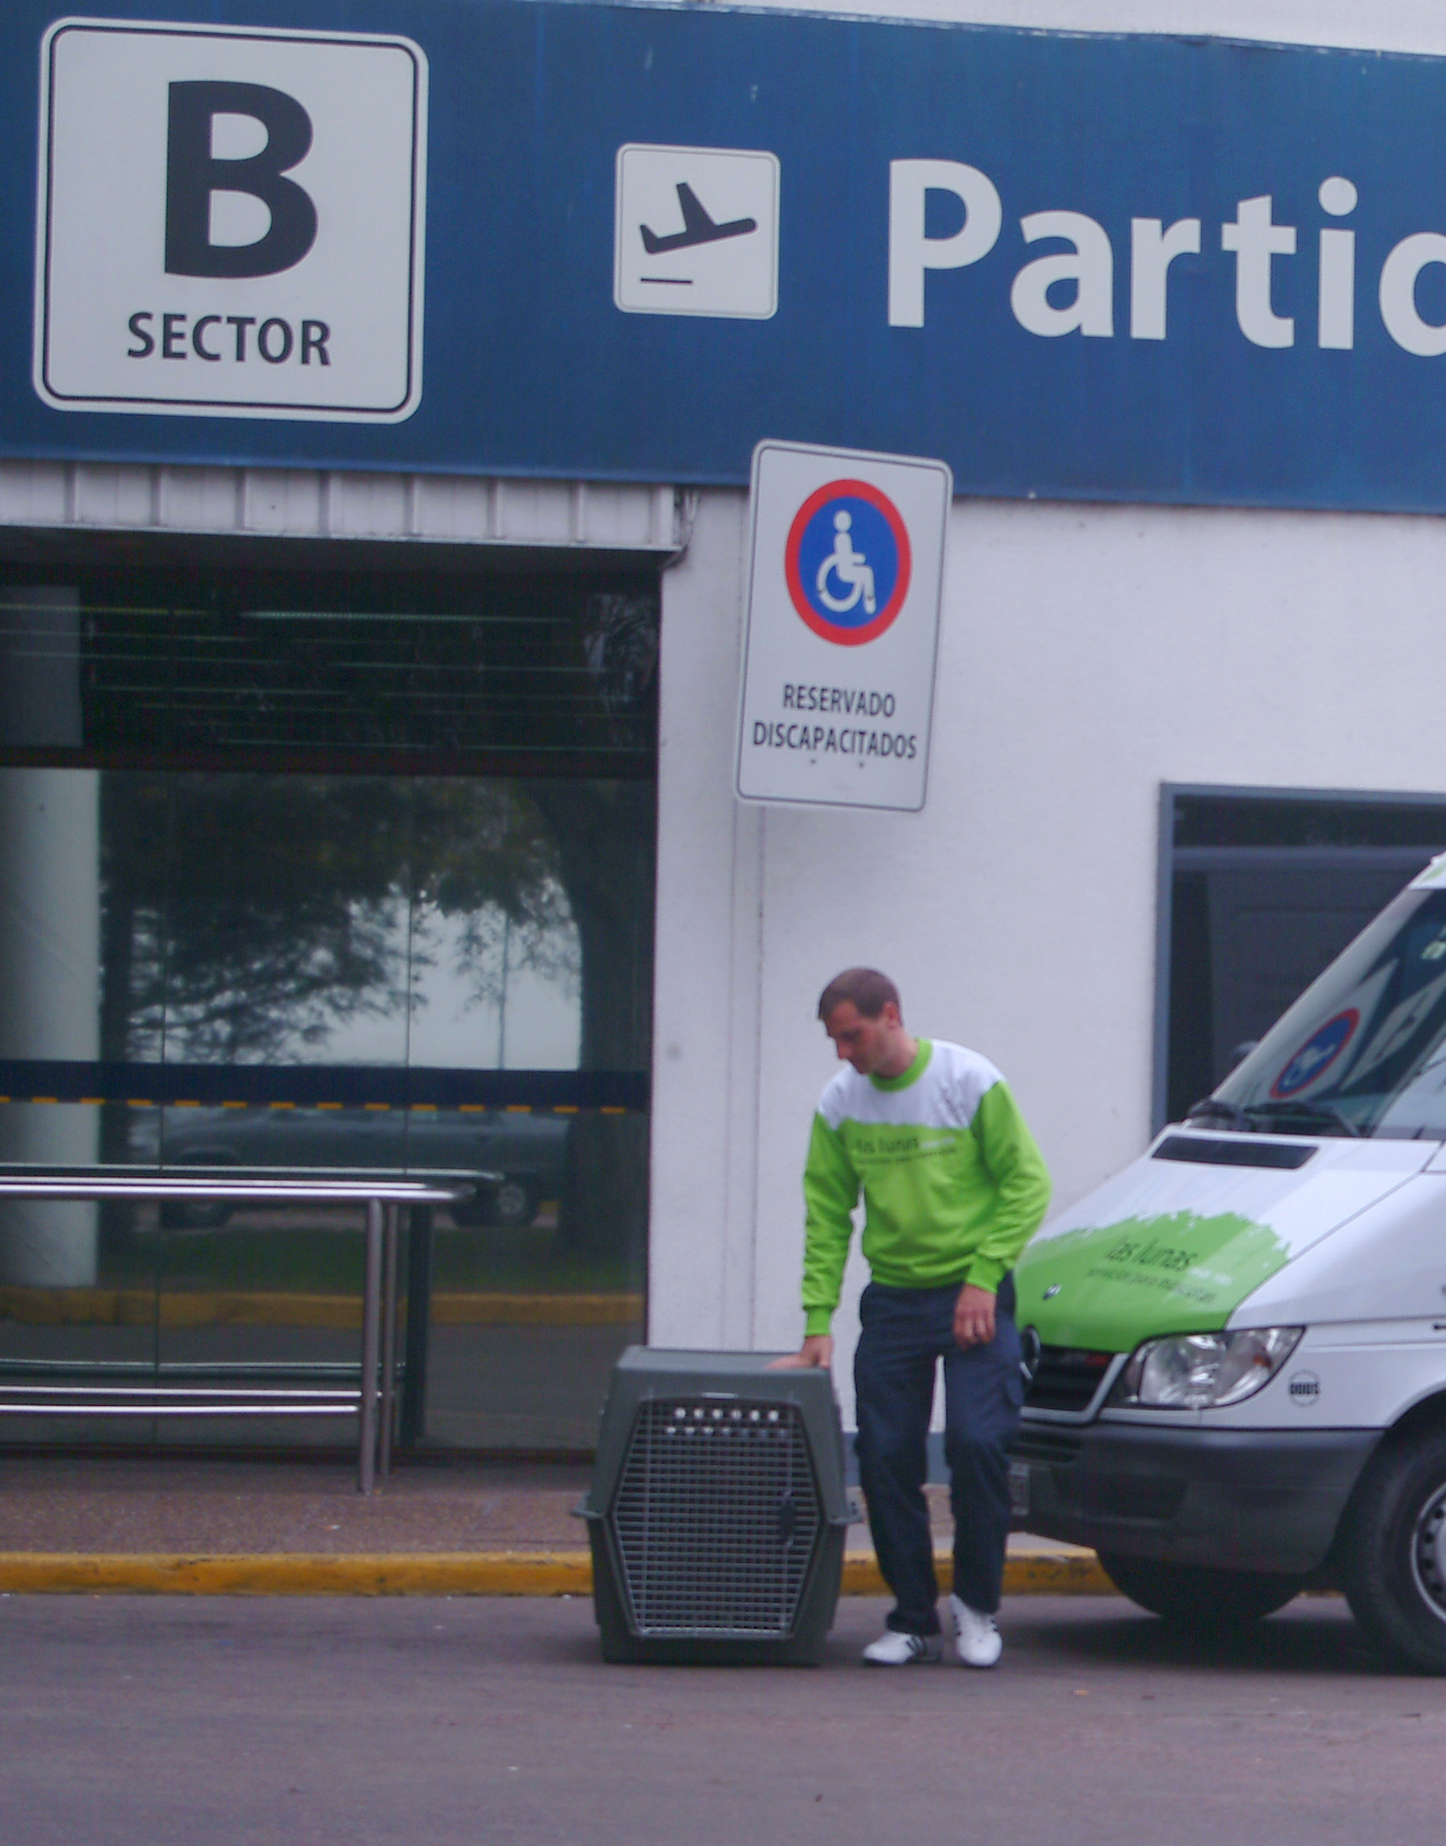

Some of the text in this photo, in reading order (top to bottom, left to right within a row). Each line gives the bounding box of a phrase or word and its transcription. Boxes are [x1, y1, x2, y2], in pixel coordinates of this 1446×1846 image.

[165, 80, 319, 279] B
[126, 313, 331, 366] SECTOR
[783, 684, 896, 717] RESERVADO
[754, 721, 917, 759] DISCAPACITADOS
